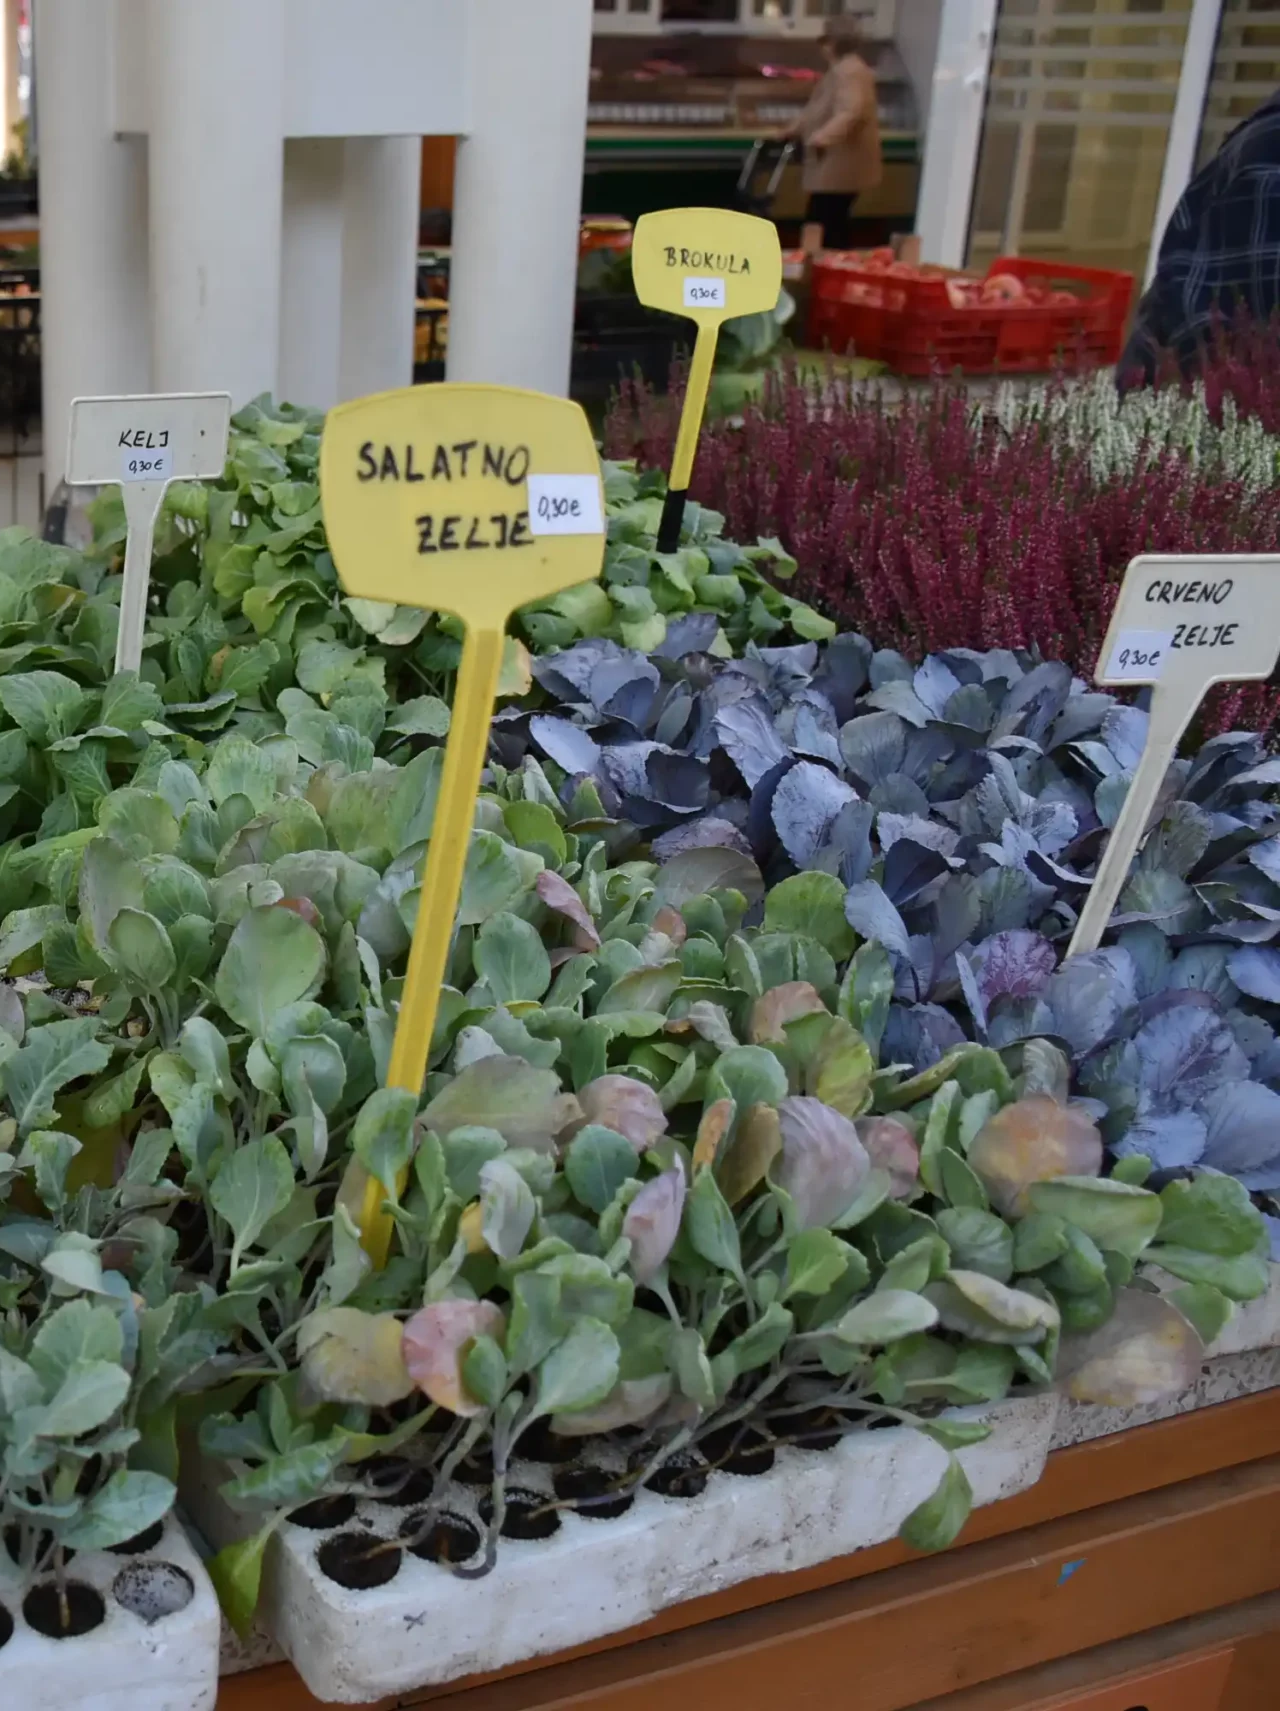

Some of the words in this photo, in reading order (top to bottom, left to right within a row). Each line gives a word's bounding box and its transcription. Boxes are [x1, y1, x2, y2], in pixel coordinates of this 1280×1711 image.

[663, 246, 751, 275] BROKULA
[118, 429, 170, 449] KELJ
[356, 440, 530, 486] SALATNO
[415, 511, 535, 555] ZELJE
[1145, 578, 1234, 605] CRVENO
[1170, 623, 1240, 650] ZELJE
